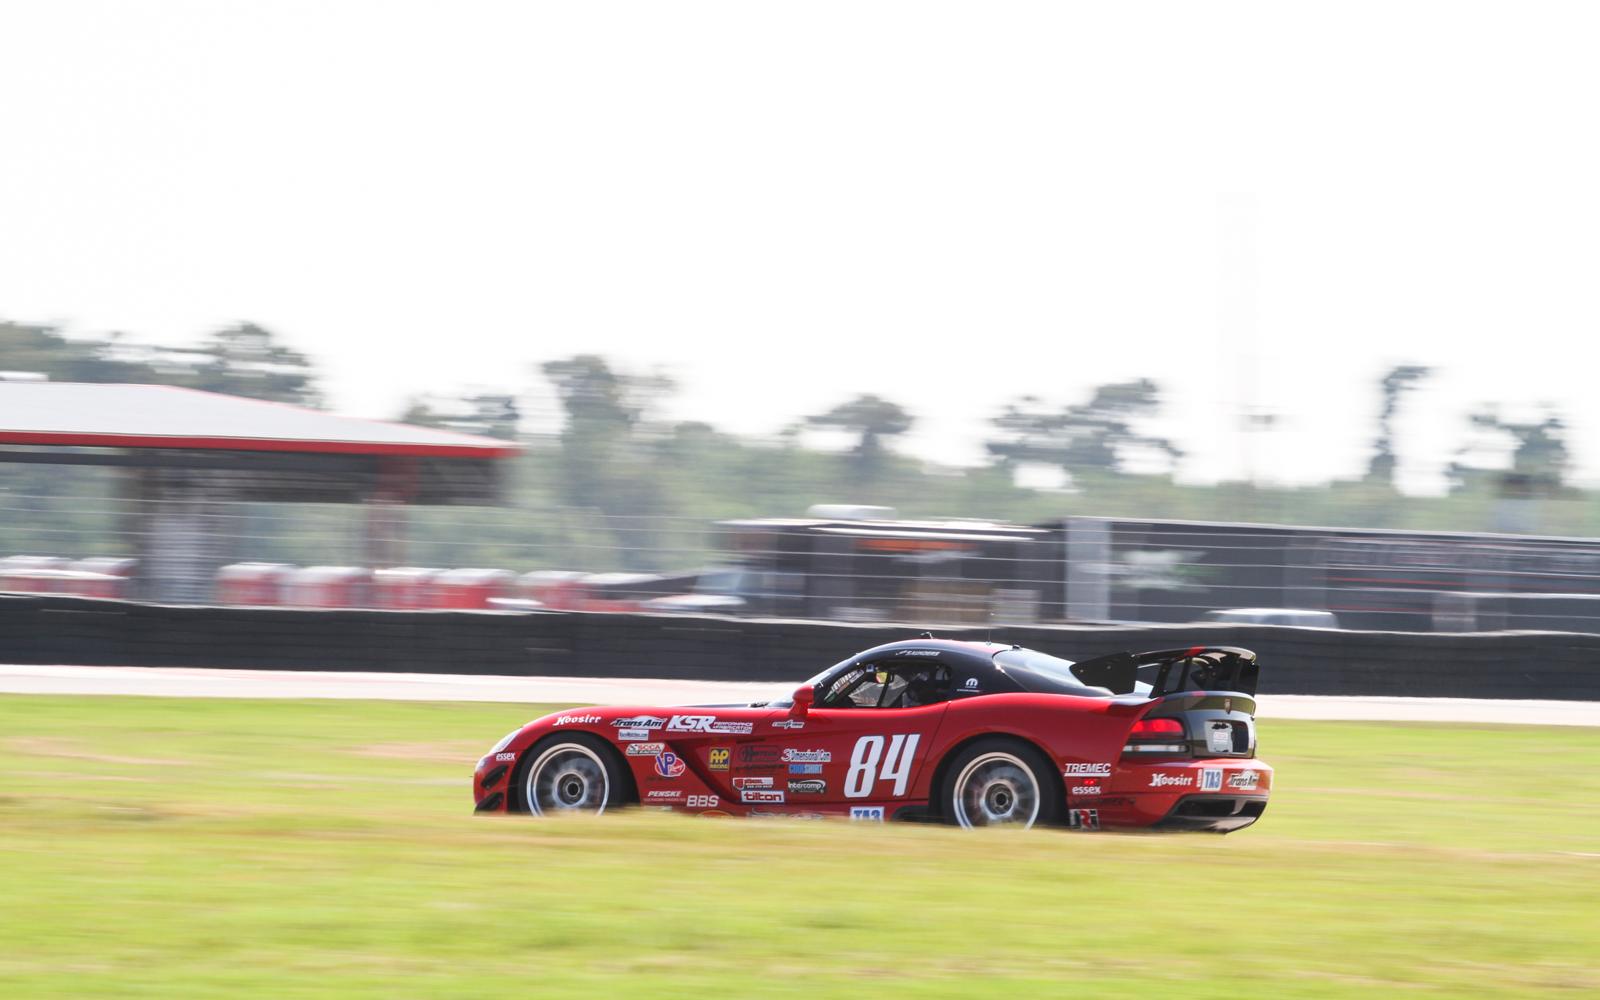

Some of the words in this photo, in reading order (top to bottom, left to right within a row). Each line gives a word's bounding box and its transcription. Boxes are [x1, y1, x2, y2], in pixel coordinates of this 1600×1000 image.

[615, 719, 642, 727] Trans
[643, 719, 662, 727] Am
[667, 715, 716, 730] KSR
[495, 752, 516, 761] essex
[710, 750, 729, 764] AP
[656, 752, 676, 776] VP
[843, 734, 921, 798] 84
[1064, 763, 1112, 773] TREMEC
[1205, 771, 1221, 789] TA3
[788, 781, 822, 790] Intercomp
[1071, 786, 1101, 795] essex
[647, 790, 683, 798] PENSKE
[743, 791, 782, 801] tilton
[686, 794, 720, 807] BBS
